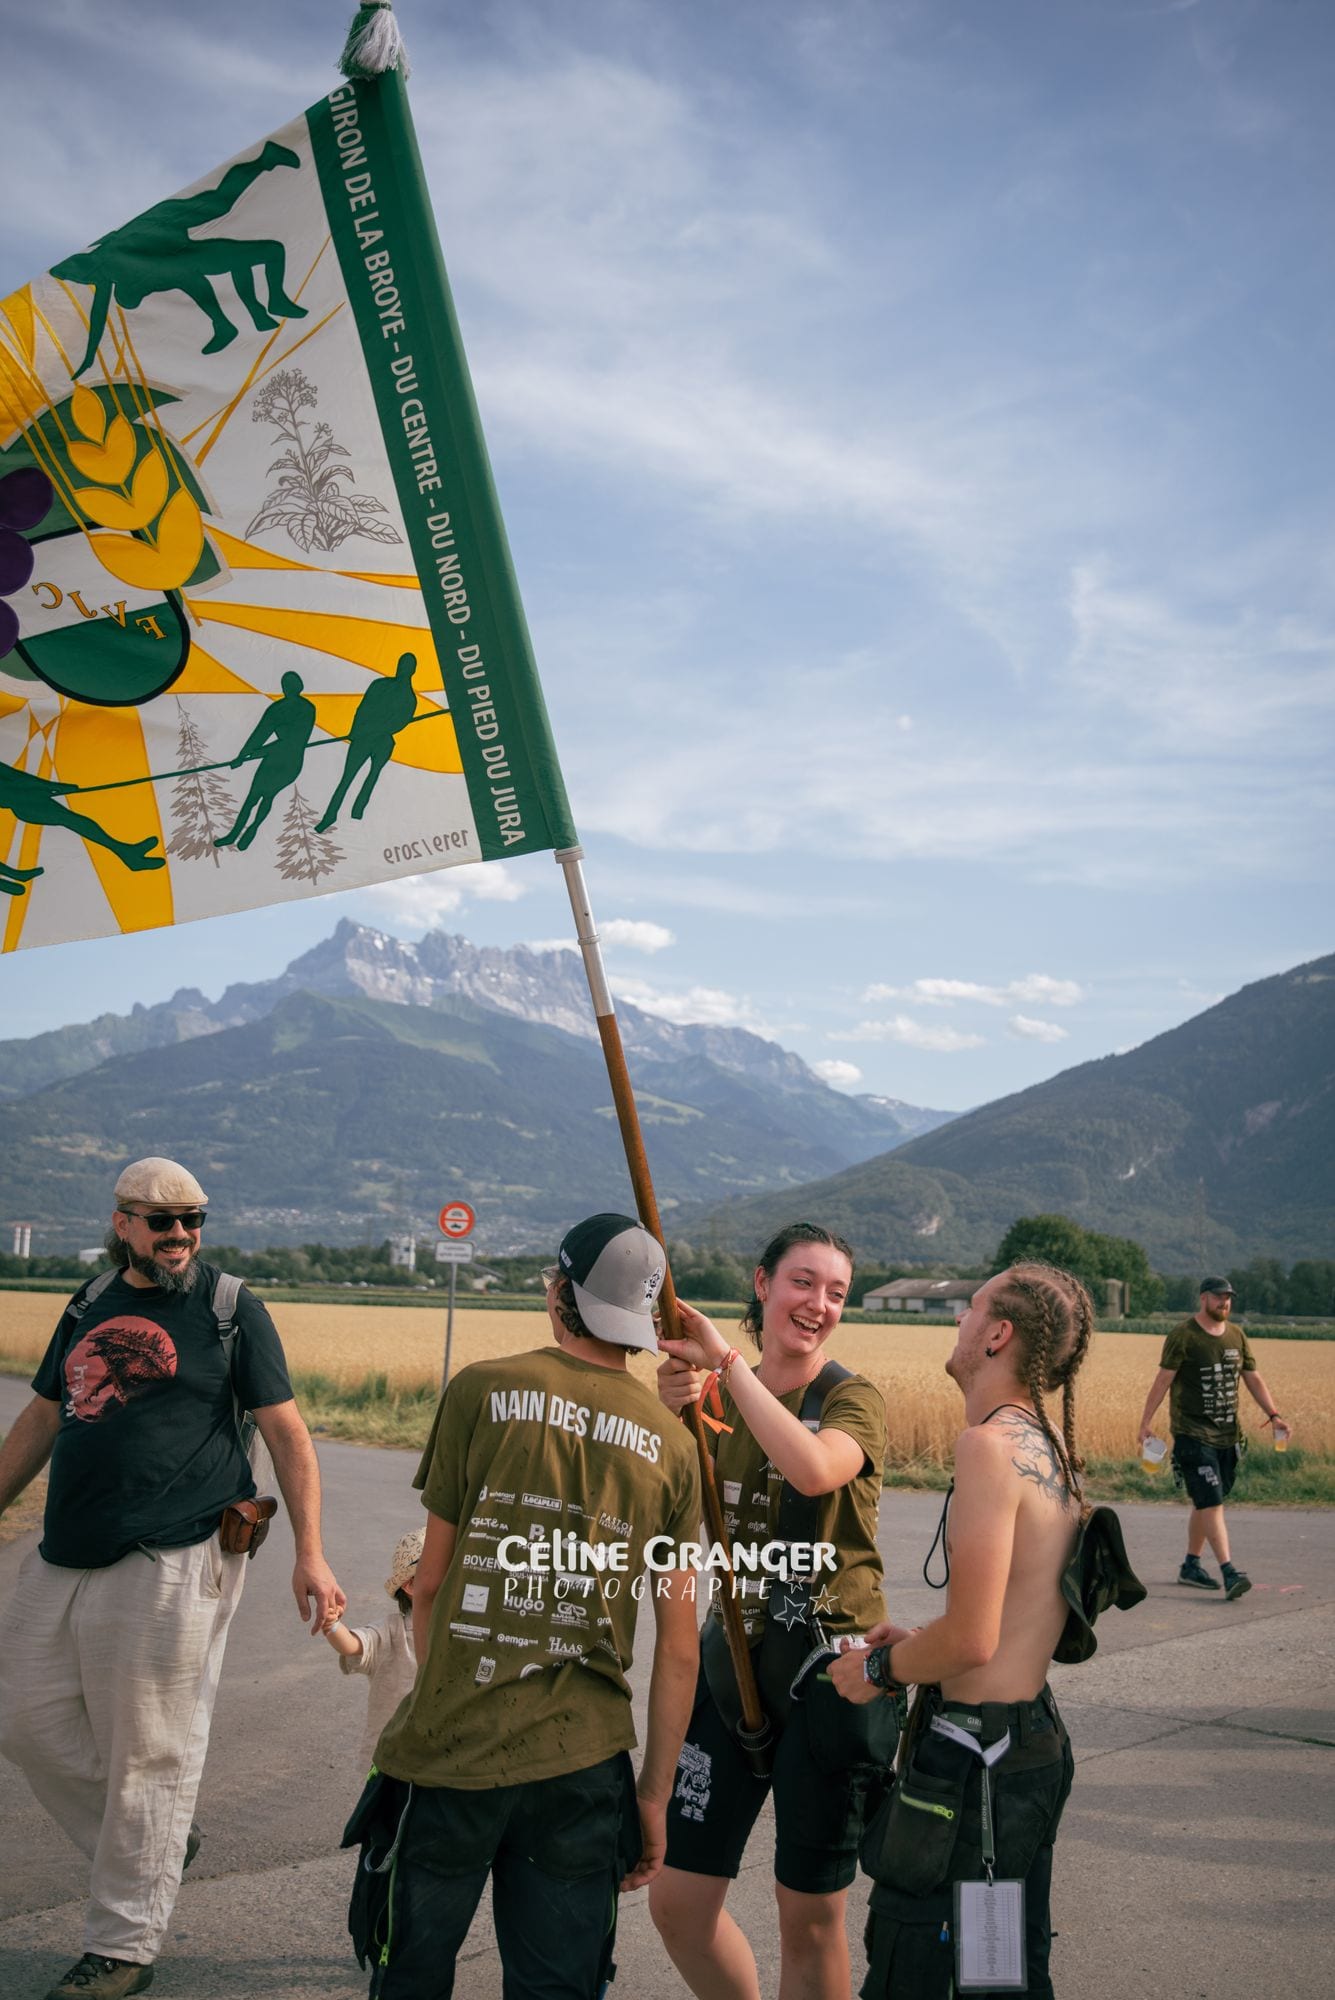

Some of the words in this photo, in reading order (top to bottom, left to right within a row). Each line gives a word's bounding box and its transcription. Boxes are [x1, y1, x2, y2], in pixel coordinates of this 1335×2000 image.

[328, 83, 368, 170] GIRON
[344, 172, 376, 212] DE
[354, 211, 384, 250] LA
[364, 250, 405, 339] BROYE
[390, 355, 418, 394] DU
[401, 398, 443, 494] CENTRE
[427, 513, 455, 550] DU
[435, 555, 471, 625] NORD
[457, 643, 486, 680] DU
[467, 684, 500, 741] PIED
[481, 744, 511, 780] DU
[490, 785, 526, 847] JURA
[490, 1389, 546, 1423] NAIN
[549, 1394, 590, 1437] DES
[592, 1411, 662, 1463] MINES
[503, 1596, 545, 1612] HUGO
[548, 1636, 583, 1655] HAAS
[967, 1717, 982, 1726] GIR
